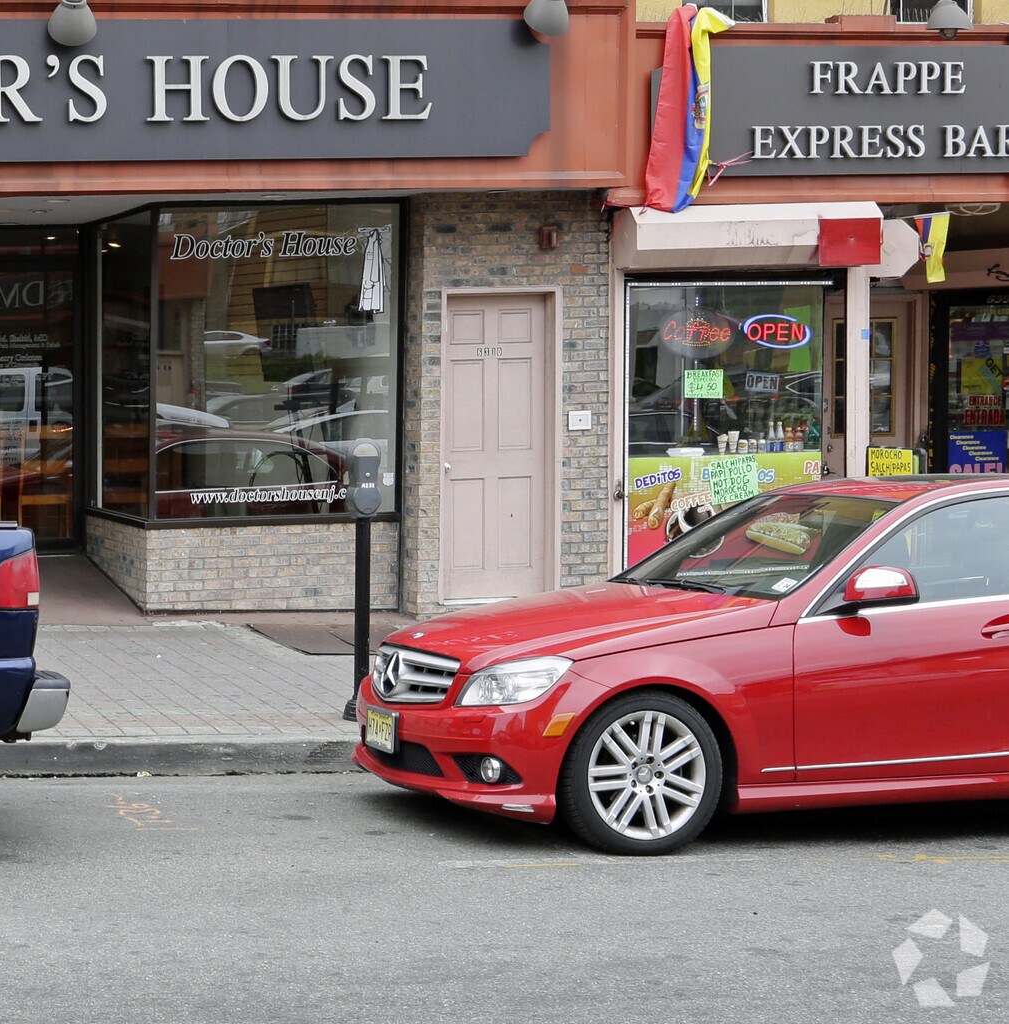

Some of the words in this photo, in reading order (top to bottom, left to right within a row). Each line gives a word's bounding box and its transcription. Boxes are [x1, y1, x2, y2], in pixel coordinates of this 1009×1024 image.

[809, 60, 967, 95] FRAPPE
[145, 54, 433, 122] HOUSE
[751, 123, 926, 159] EXPRESS
[170, 231, 275, 260] Doctor's
[279, 230, 357, 257] House
[746, 322, 806, 342] OPEN
[747, 374, 779, 390] OPEN
[710, 454, 756, 471] SALCHIPAPAS
[870, 449, 902, 460] MOROCHO
[710, 469, 726, 479] PAPI
[729, 464, 753, 477] POLLO
[713, 478, 728, 489] HOT
[731, 475, 750, 486] DOG
[190, 484, 347, 504] www.doctorshousenj.c
[713, 485, 748, 498] MOROCHO
[729, 490, 755, 501] CREAM
[671, 491, 712, 512] COFFEE
